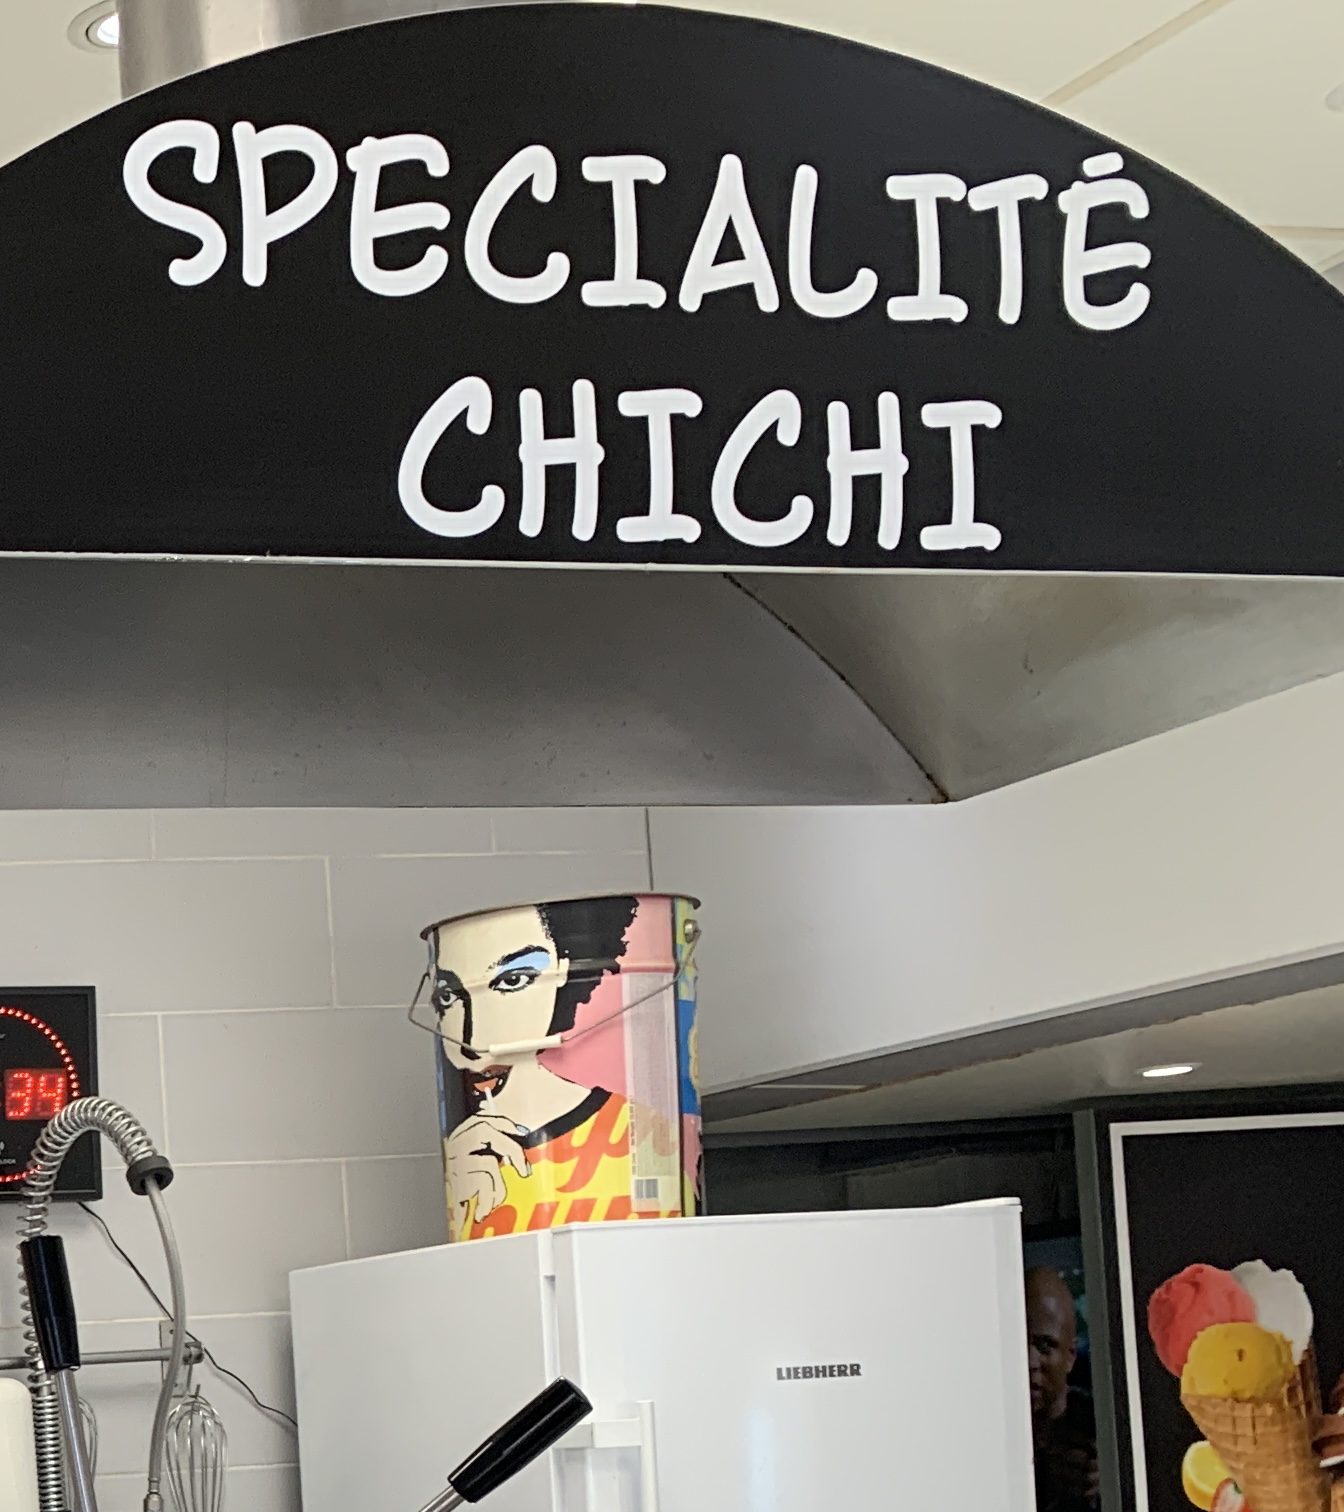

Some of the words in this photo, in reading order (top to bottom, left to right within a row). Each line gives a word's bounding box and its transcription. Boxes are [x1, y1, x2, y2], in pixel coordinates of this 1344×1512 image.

[122, 119, 1152, 331] SPECIALITÉ
[397, 375, 1003, 551] CHICHI
[776, 1363, 862, 1381] LIEBHERR
